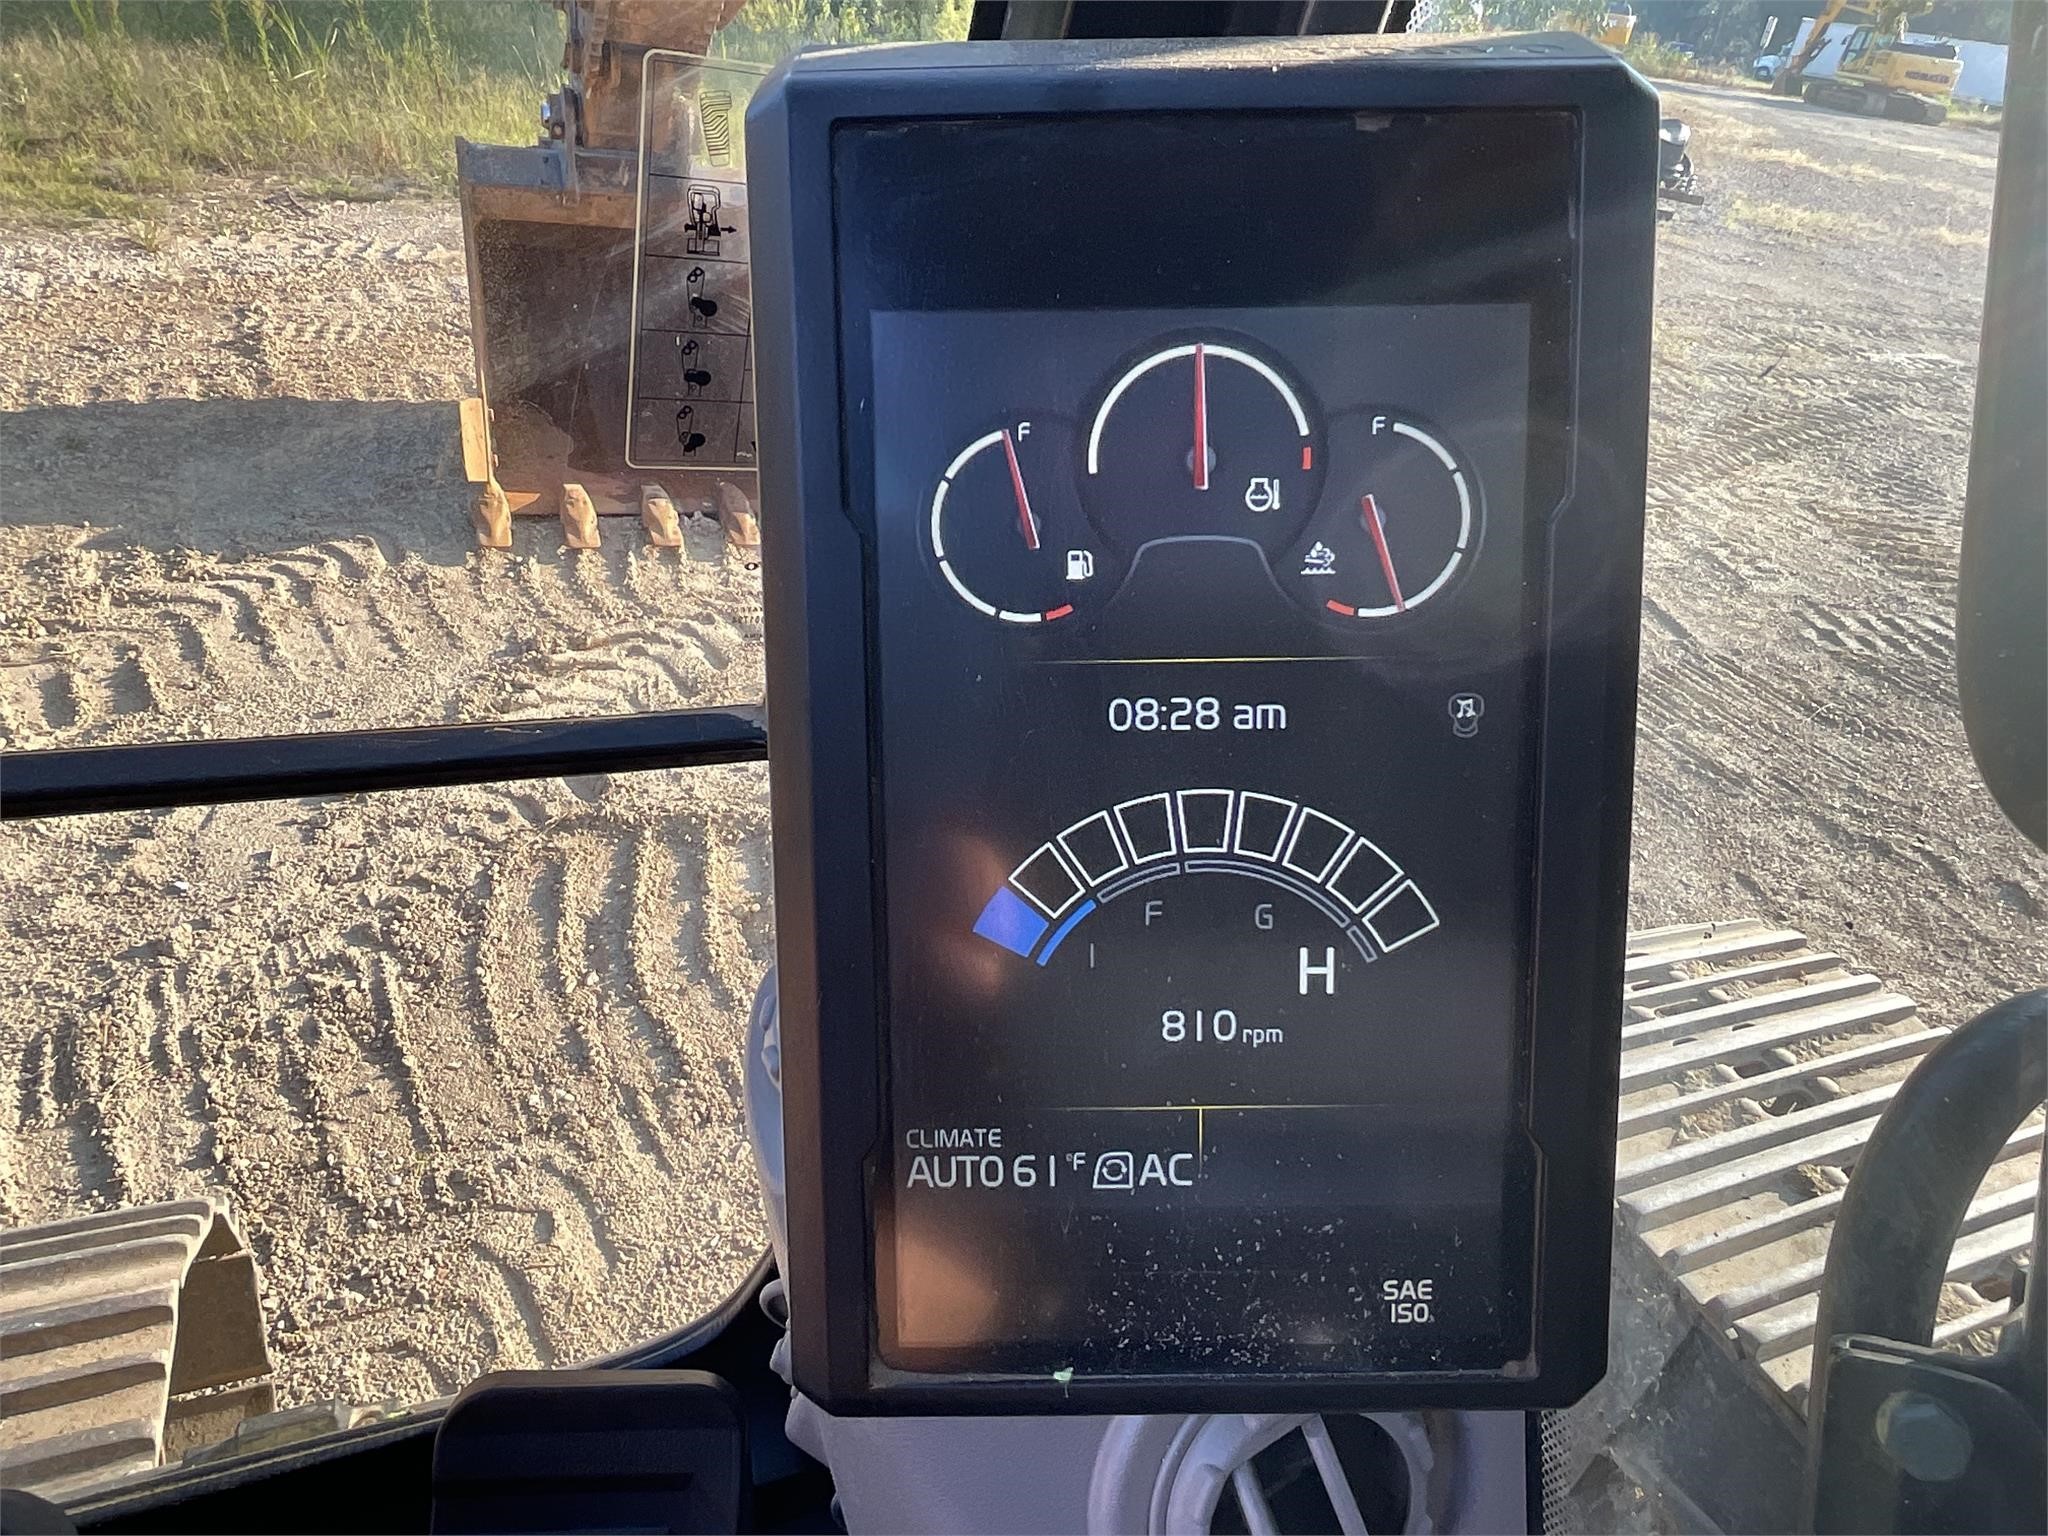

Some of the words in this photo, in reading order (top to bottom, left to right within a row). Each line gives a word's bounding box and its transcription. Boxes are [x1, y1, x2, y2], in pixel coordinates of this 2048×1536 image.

[1016, 422, 1031, 442] F
[1372, 416, 1387, 435] F
[1108, 697, 1220, 731] 08:28
[1233, 704, 1287, 731] am
[1145, 900, 1163, 926] F
[1254, 903, 1273, 930] G
[1299, 946, 1335, 995] H
[1161, 1009, 1237, 1042] 810
[1242, 1028, 1283, 1048] rpm
[906, 1128, 1002, 1148] CLIMATE
[906, 1155, 1004, 1188] AUTO
[1013, 1154, 1056, 1187] 61
[1139, 1153, 1193, 1186] AC
[1383, 1279, 1433, 1300] SAE
[1391, 1303, 1429, 1323] ISO
